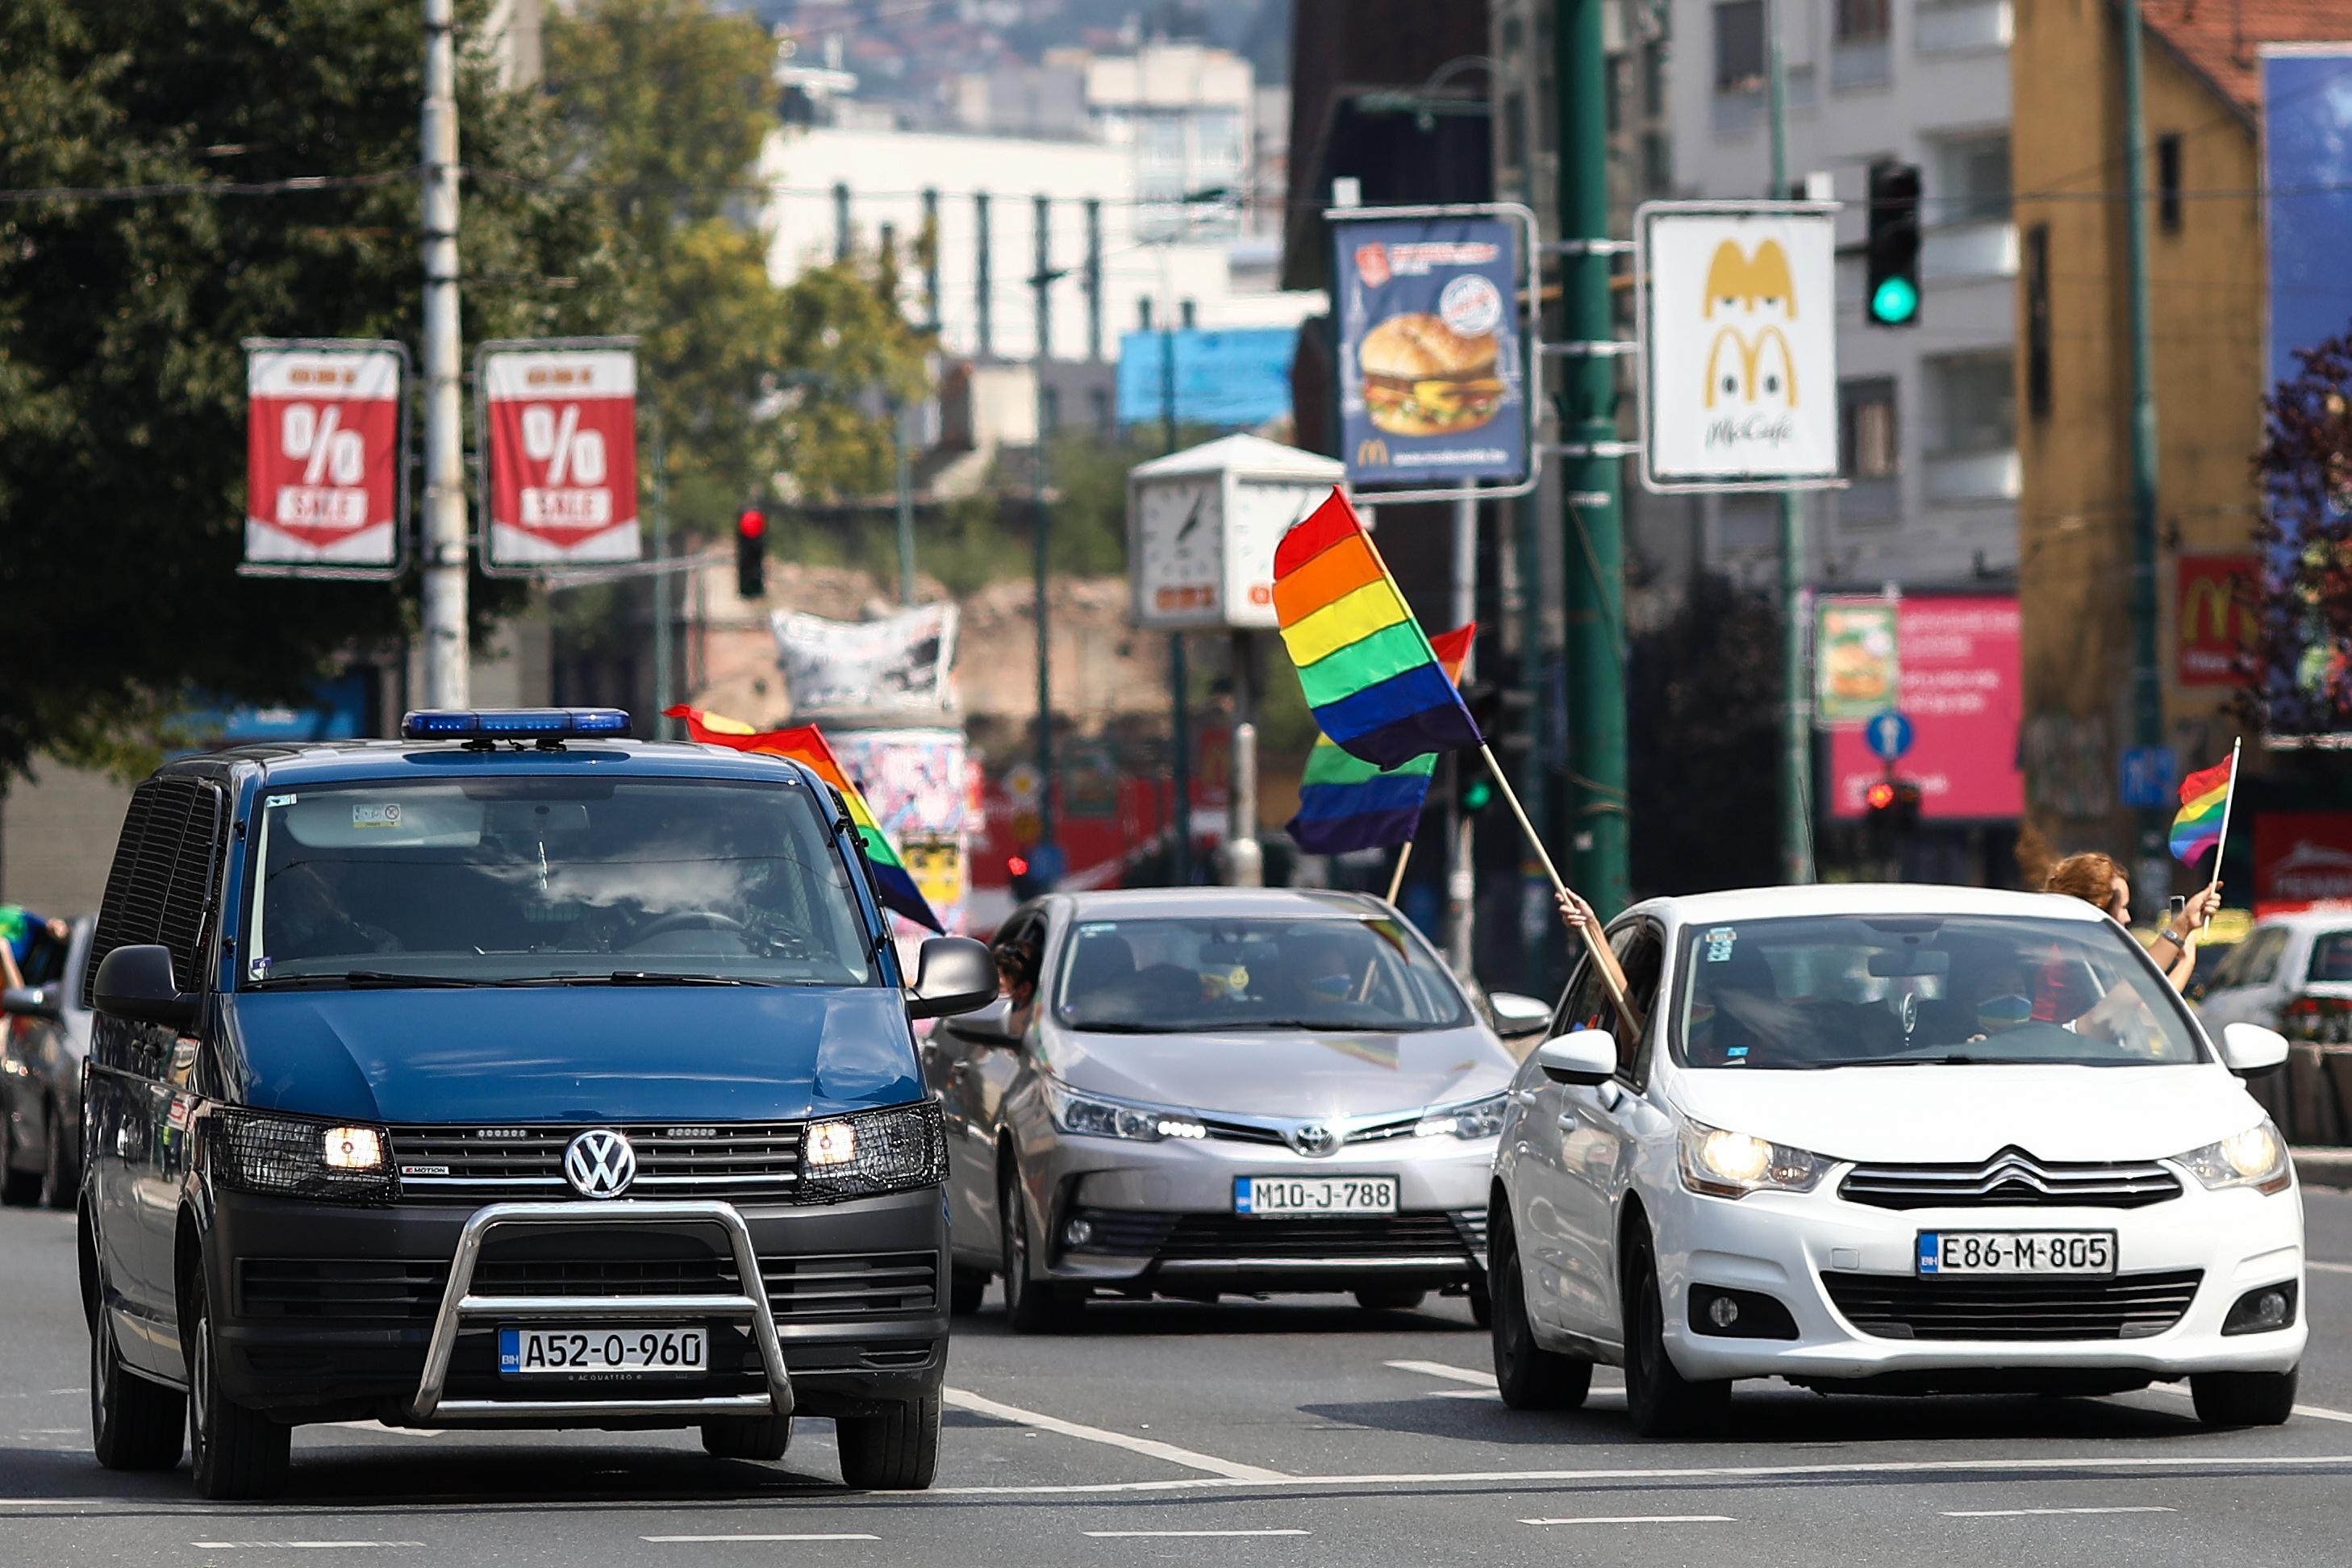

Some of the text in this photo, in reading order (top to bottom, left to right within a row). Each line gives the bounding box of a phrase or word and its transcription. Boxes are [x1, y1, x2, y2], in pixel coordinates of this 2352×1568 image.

[1255, 1183, 1391, 1208] M10-J-788
[1942, 1238, 2107, 1268] E86-M-805
[502, 1354, 519, 1365] BIH
